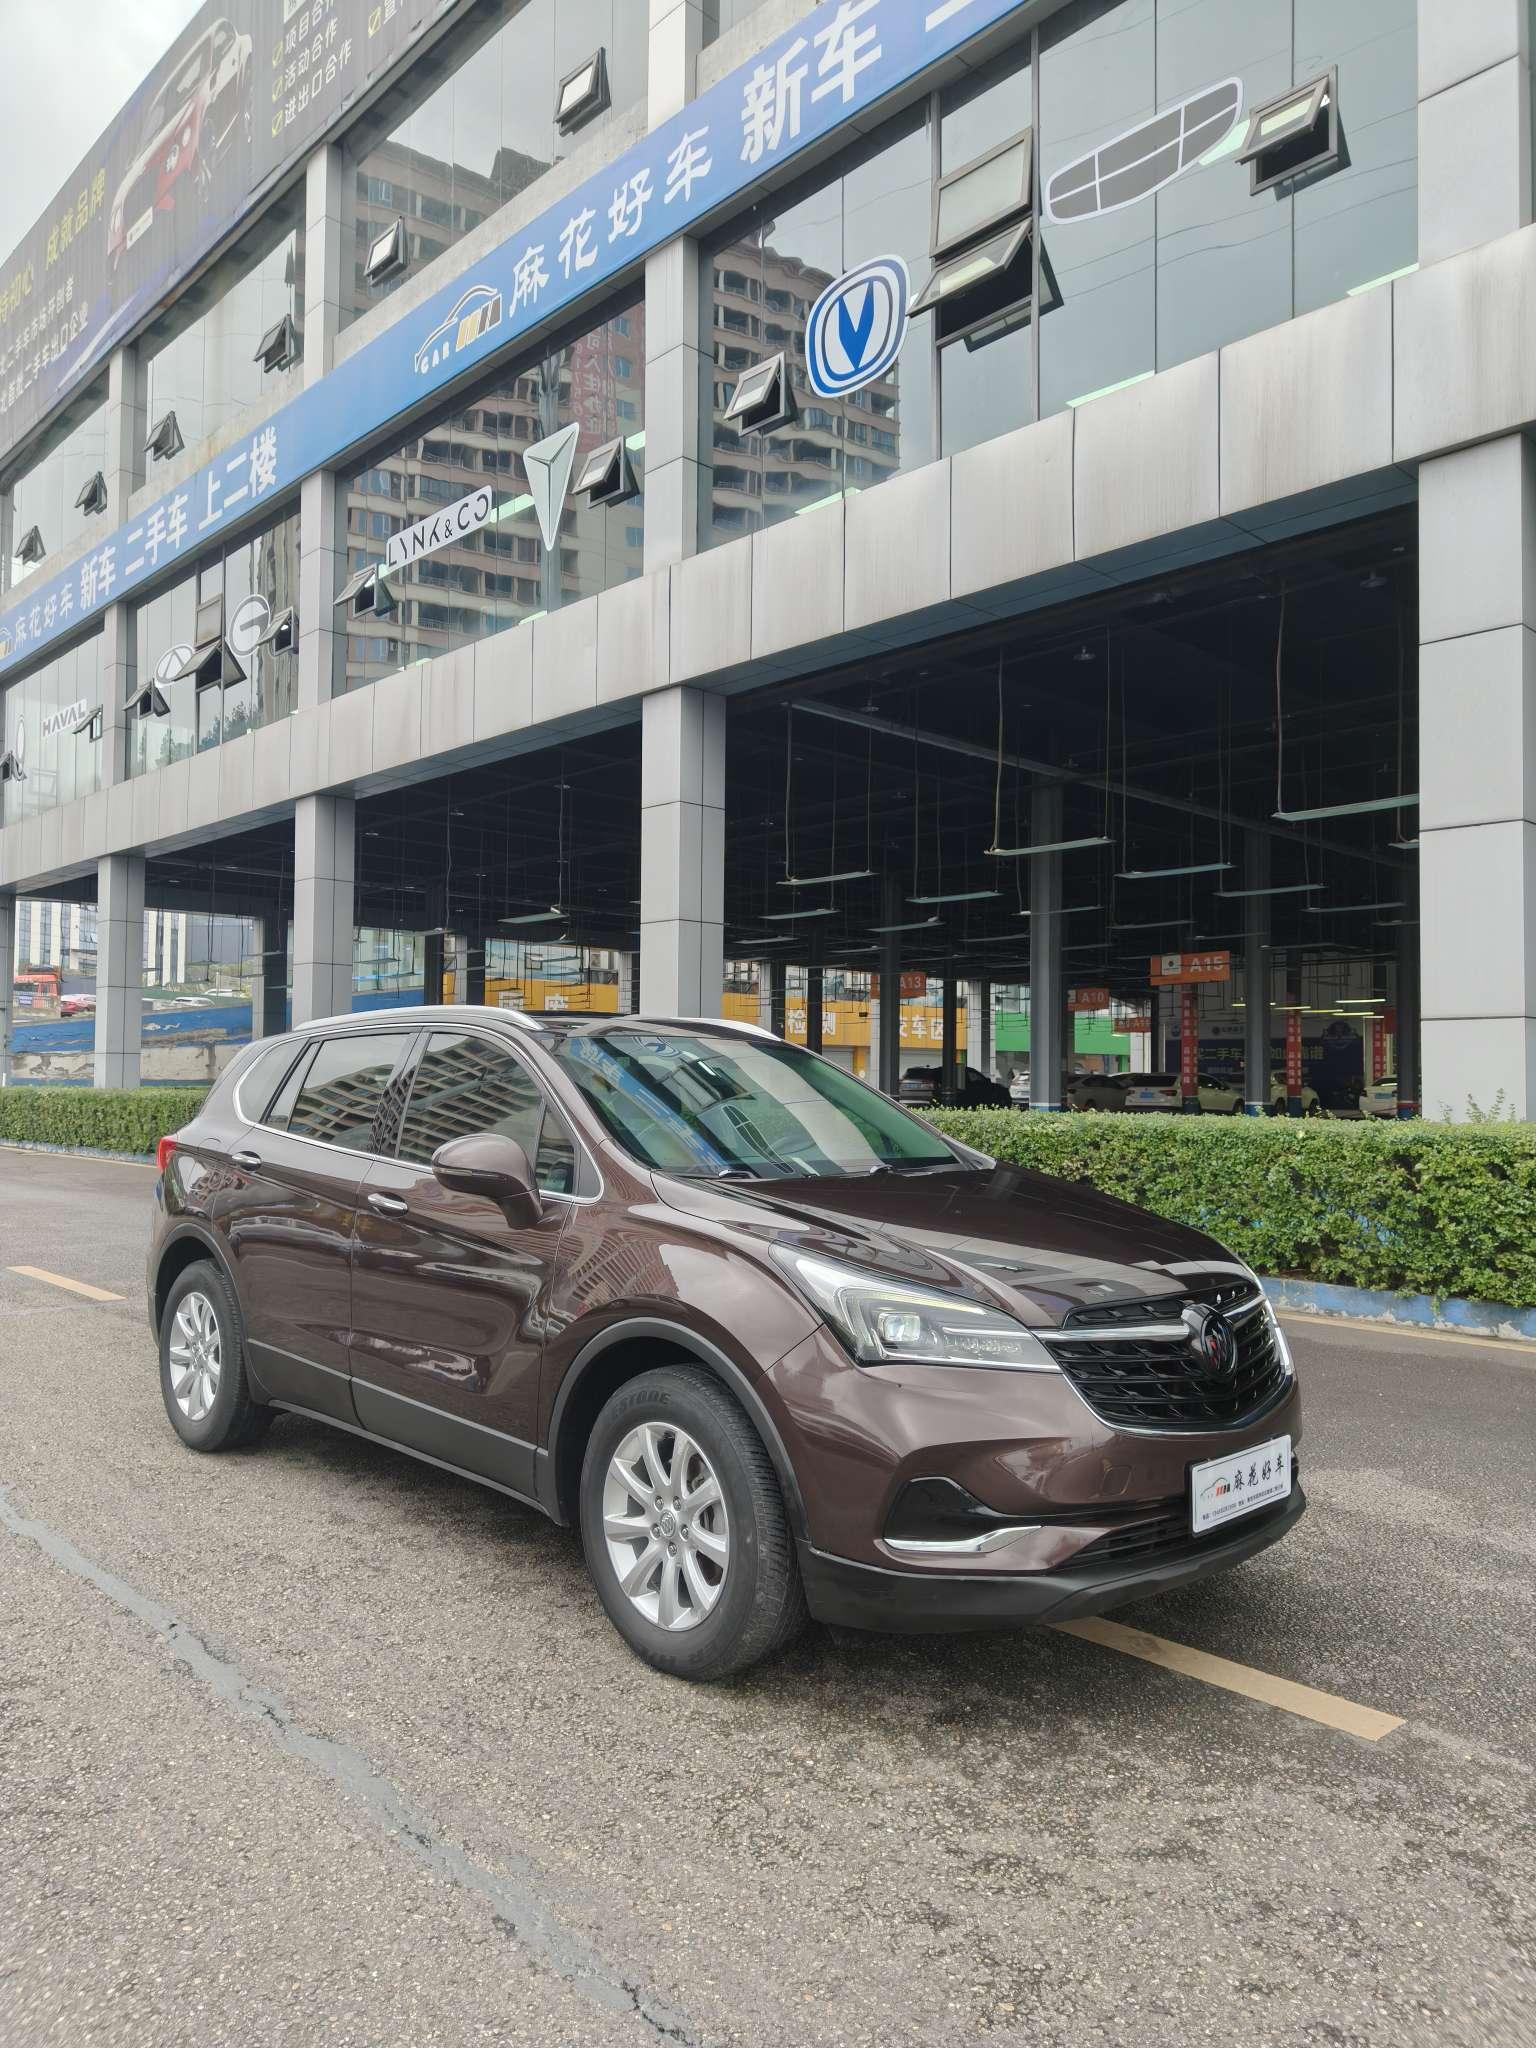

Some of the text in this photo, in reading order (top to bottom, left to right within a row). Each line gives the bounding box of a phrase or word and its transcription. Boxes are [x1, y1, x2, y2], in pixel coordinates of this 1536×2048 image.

[284, 17, 338, 92] 活动合作
[284, 38, 353, 127] 进出口合作
[509, 0, 882, 318] 麻花好车 新车
[15, 426, 278, 652] 麻花好车 新车 二手车 上二楼
[42, 701, 87, 738] HAVAL
[900, 975, 921, 989] A13
[1190, 956, 1225, 973] A15
[1081, 991, 1105, 1003] A10
